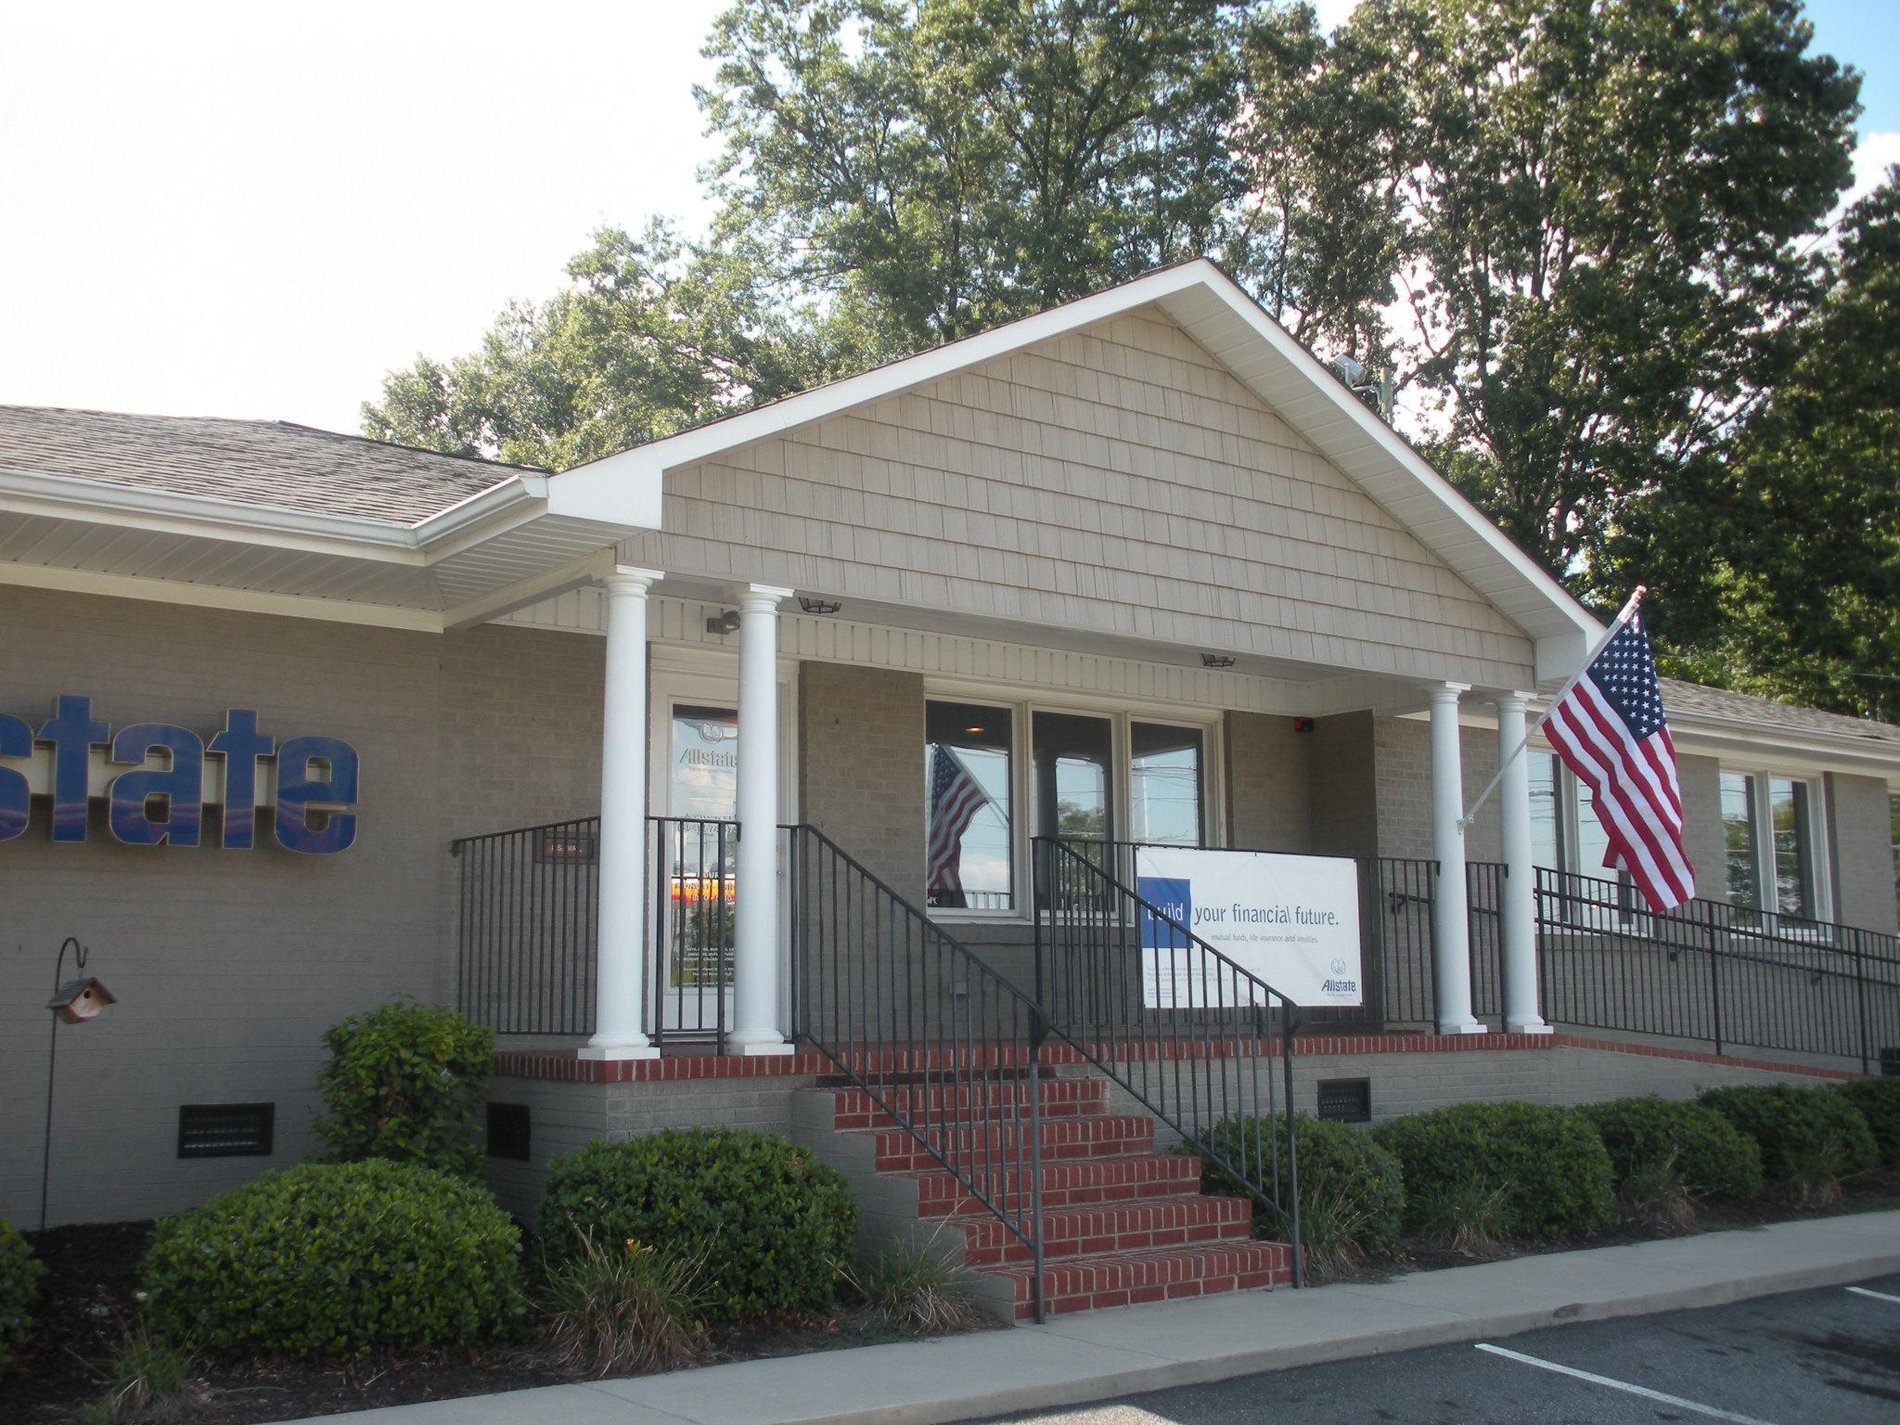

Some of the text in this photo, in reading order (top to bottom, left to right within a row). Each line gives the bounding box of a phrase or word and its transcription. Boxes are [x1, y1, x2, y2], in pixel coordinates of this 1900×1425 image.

[1194, 906, 1226, 925] your
[1233, 903, 1292, 924] financial
[1295, 906, 1339, 926] future.
[1321, 979, 1357, 993] Allstate
